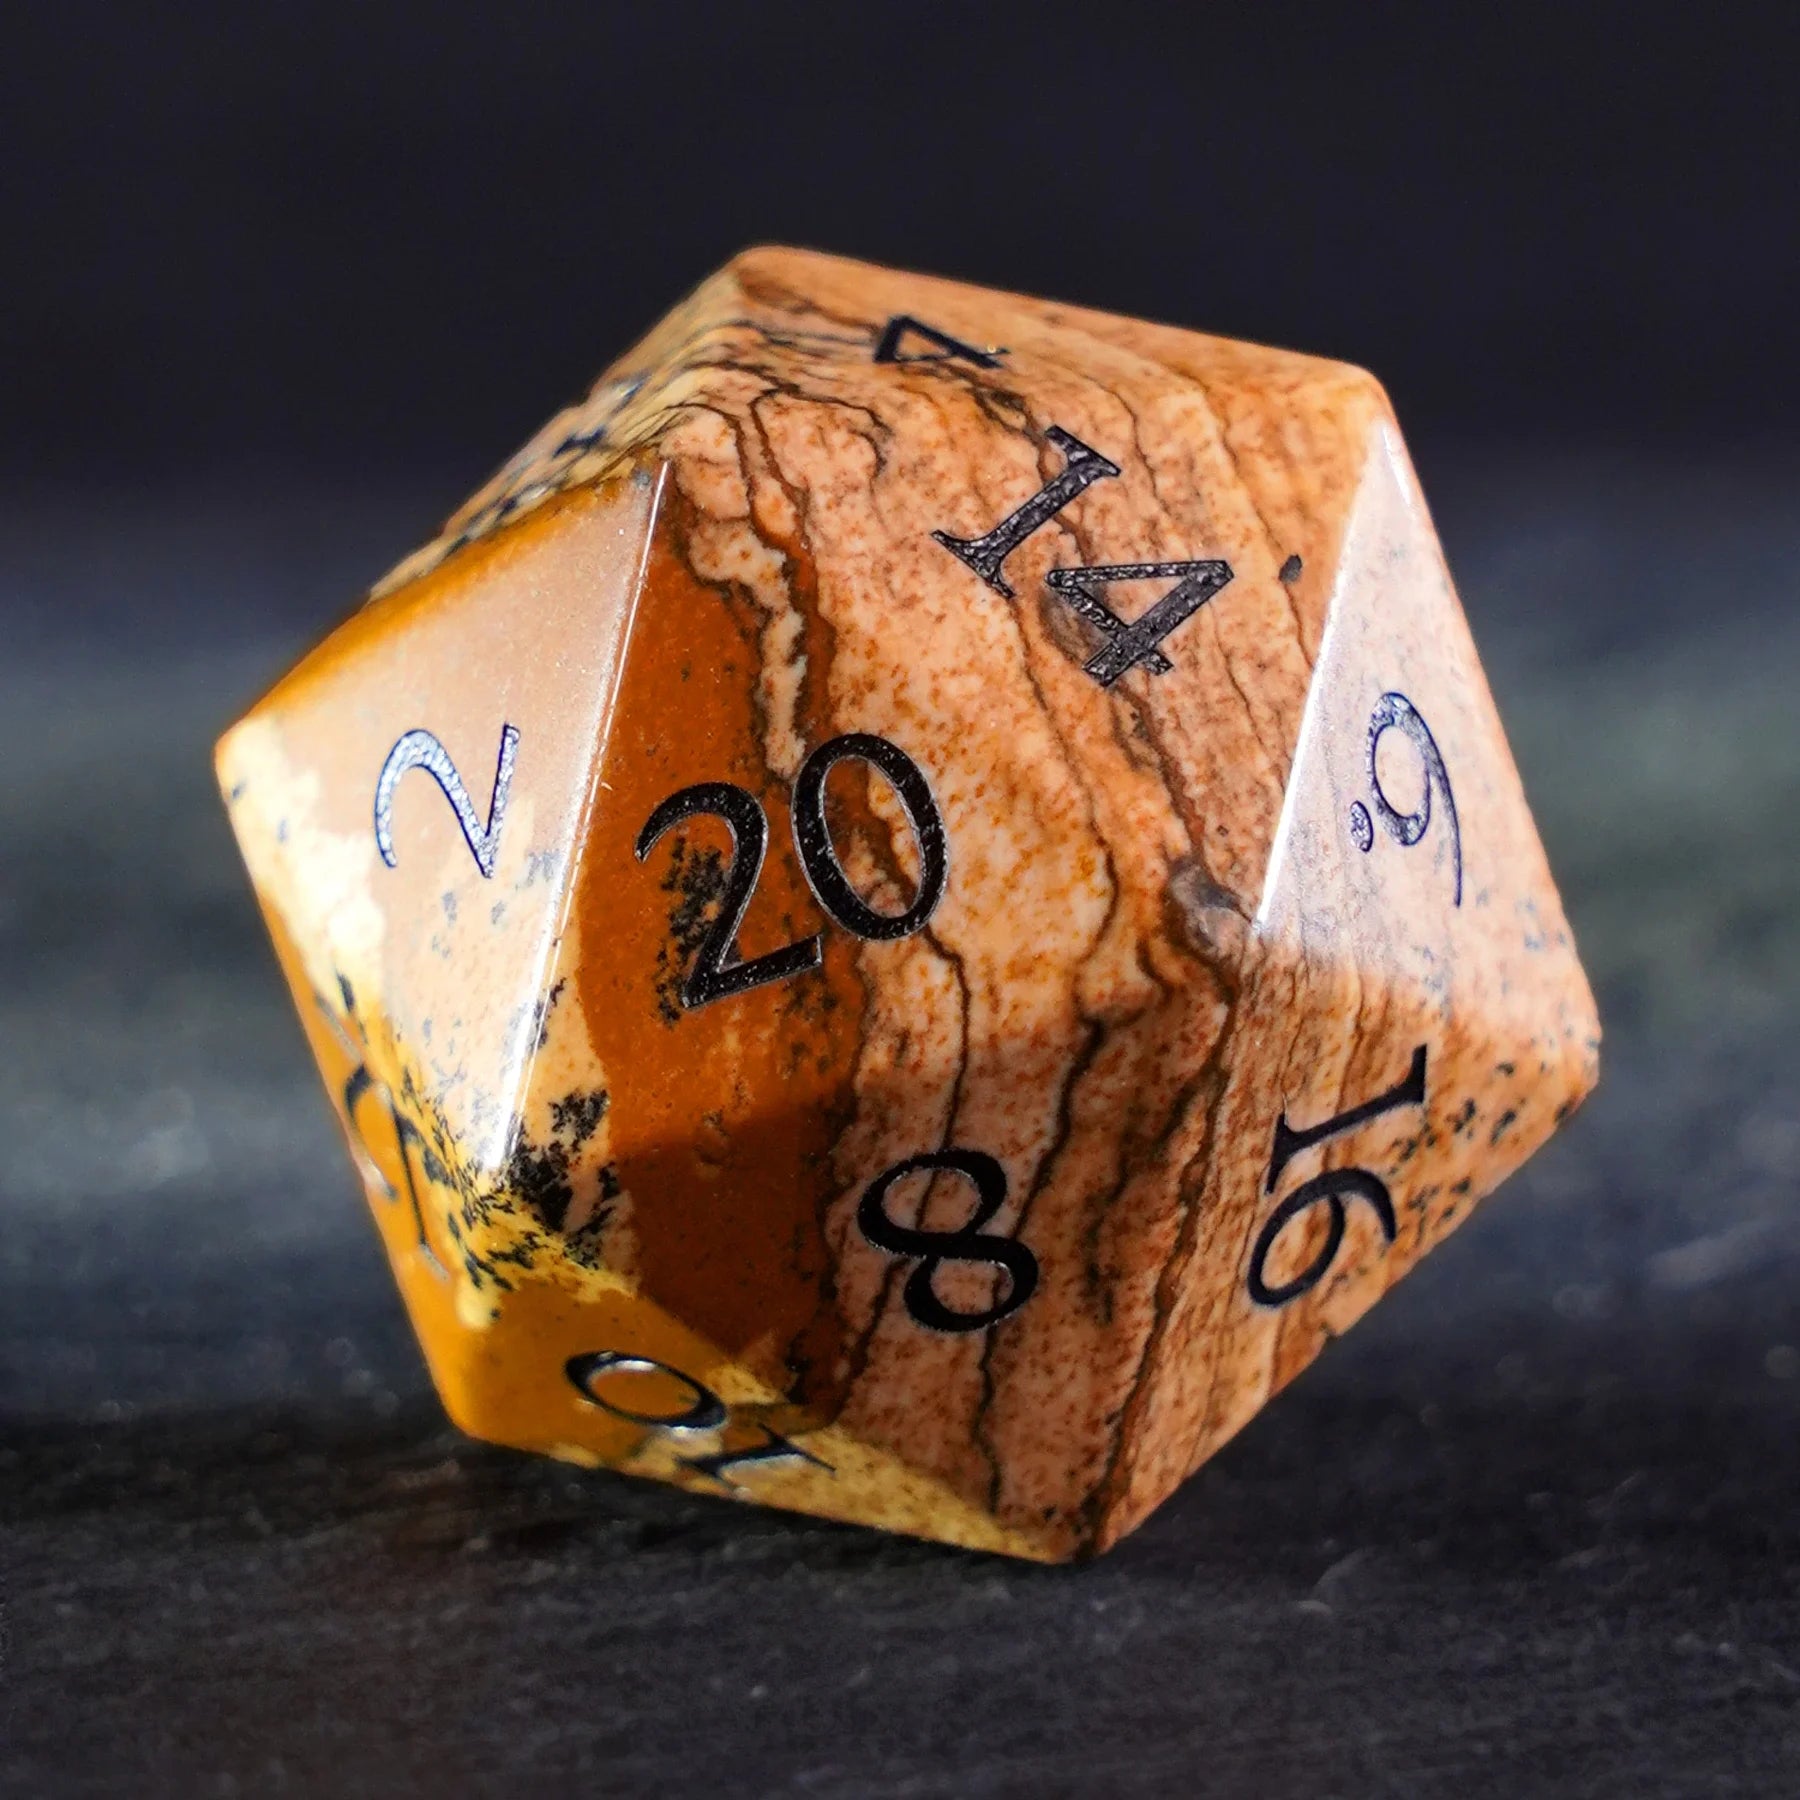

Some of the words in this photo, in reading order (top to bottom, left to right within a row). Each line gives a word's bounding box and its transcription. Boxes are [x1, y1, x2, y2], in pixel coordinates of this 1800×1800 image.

[875, 314, 1012, 368] 4
[930, 424, 1235, 688] 14
[374, 722, 521, 879] 2
[634, 732, 949, 1012] 20
[857, 1148, 1039, 1333] 8
[1247, 1043, 1428, 1308] 16
